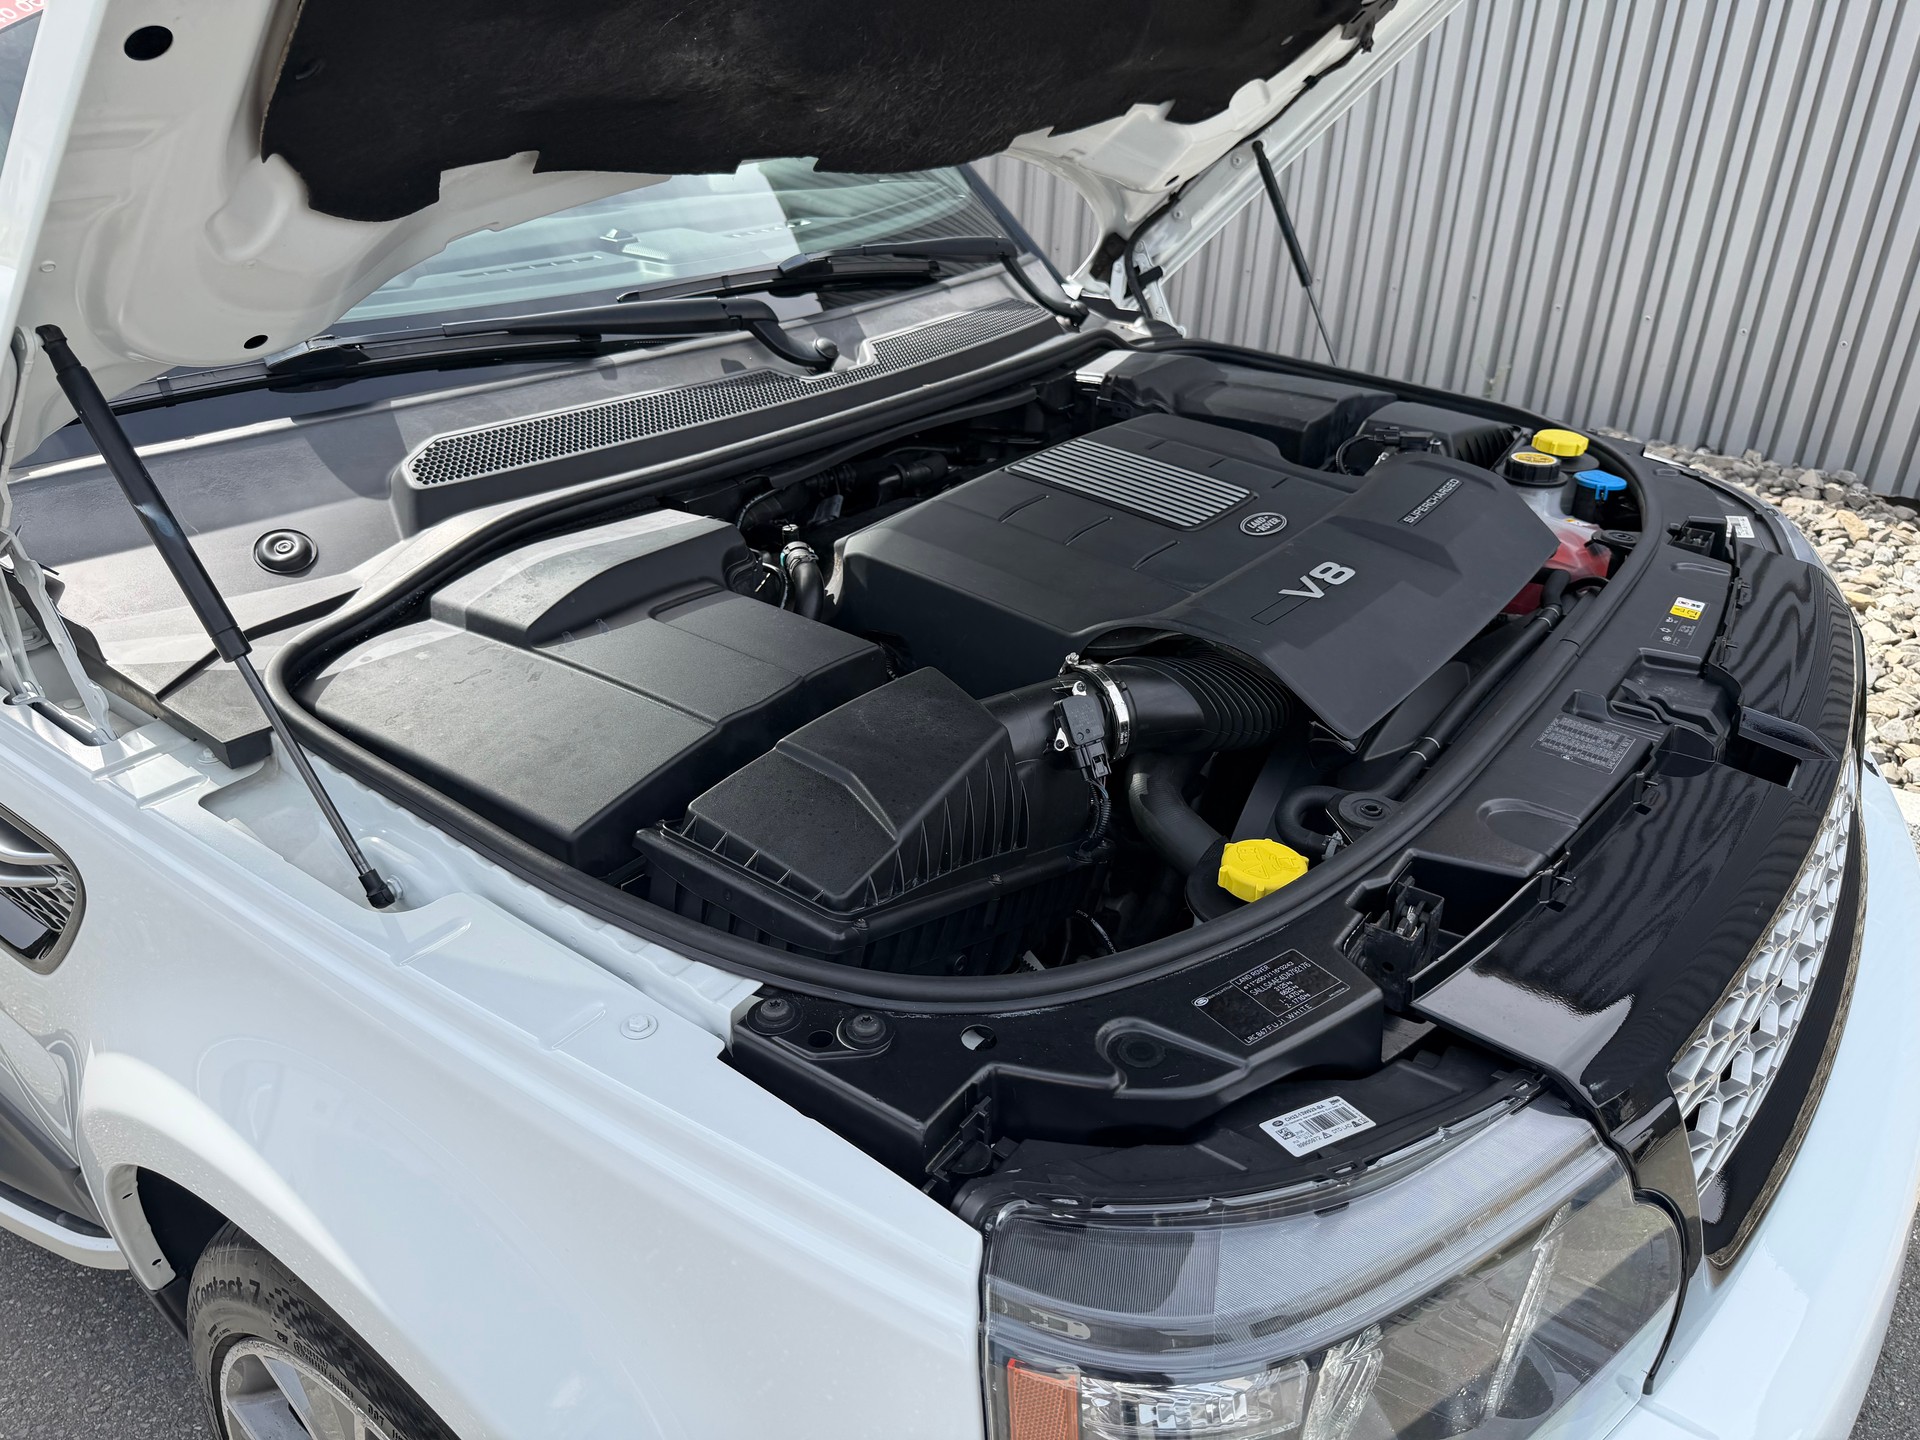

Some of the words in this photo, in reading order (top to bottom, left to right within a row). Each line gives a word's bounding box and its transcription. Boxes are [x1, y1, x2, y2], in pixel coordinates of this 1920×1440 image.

[1402, 477, 1461, 525] SUPERCHARGED
[1246, 516, 1267, 529] LAND
[1257, 517, 1282, 532] ROVER
[1277, 561, 1356, 599] V8
[1234, 974, 1253, 985] LAND
[1250, 964, 1270, 977] ROVER
[1285, 1003, 1312, 1020] WHITE
[249, 1278, 261, 1305] 7
